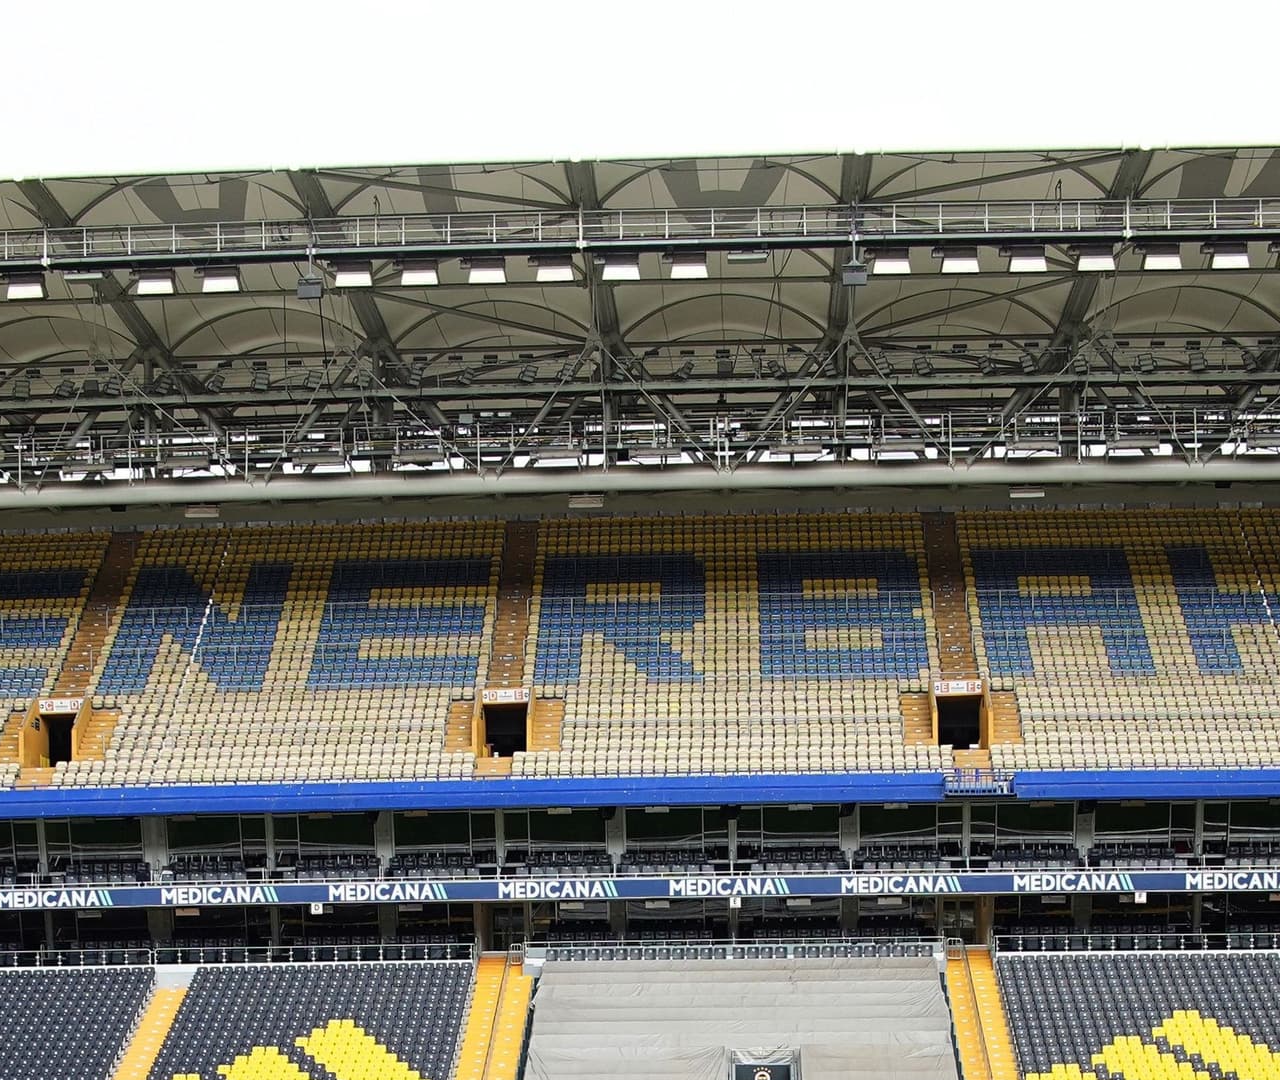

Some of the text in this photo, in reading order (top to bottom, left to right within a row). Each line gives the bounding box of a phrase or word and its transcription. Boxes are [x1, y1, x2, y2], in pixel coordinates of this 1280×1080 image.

[498, 881, 604, 899] MEDICANA
[668, 878, 776, 896] MEDICANA
[841, 876, 948, 893] MEDICANA
[1013, 874, 1120, 891] MEDICANA
[161, 886, 266, 904] MEDICANA
[328, 884, 434, 901] MEDICANA
